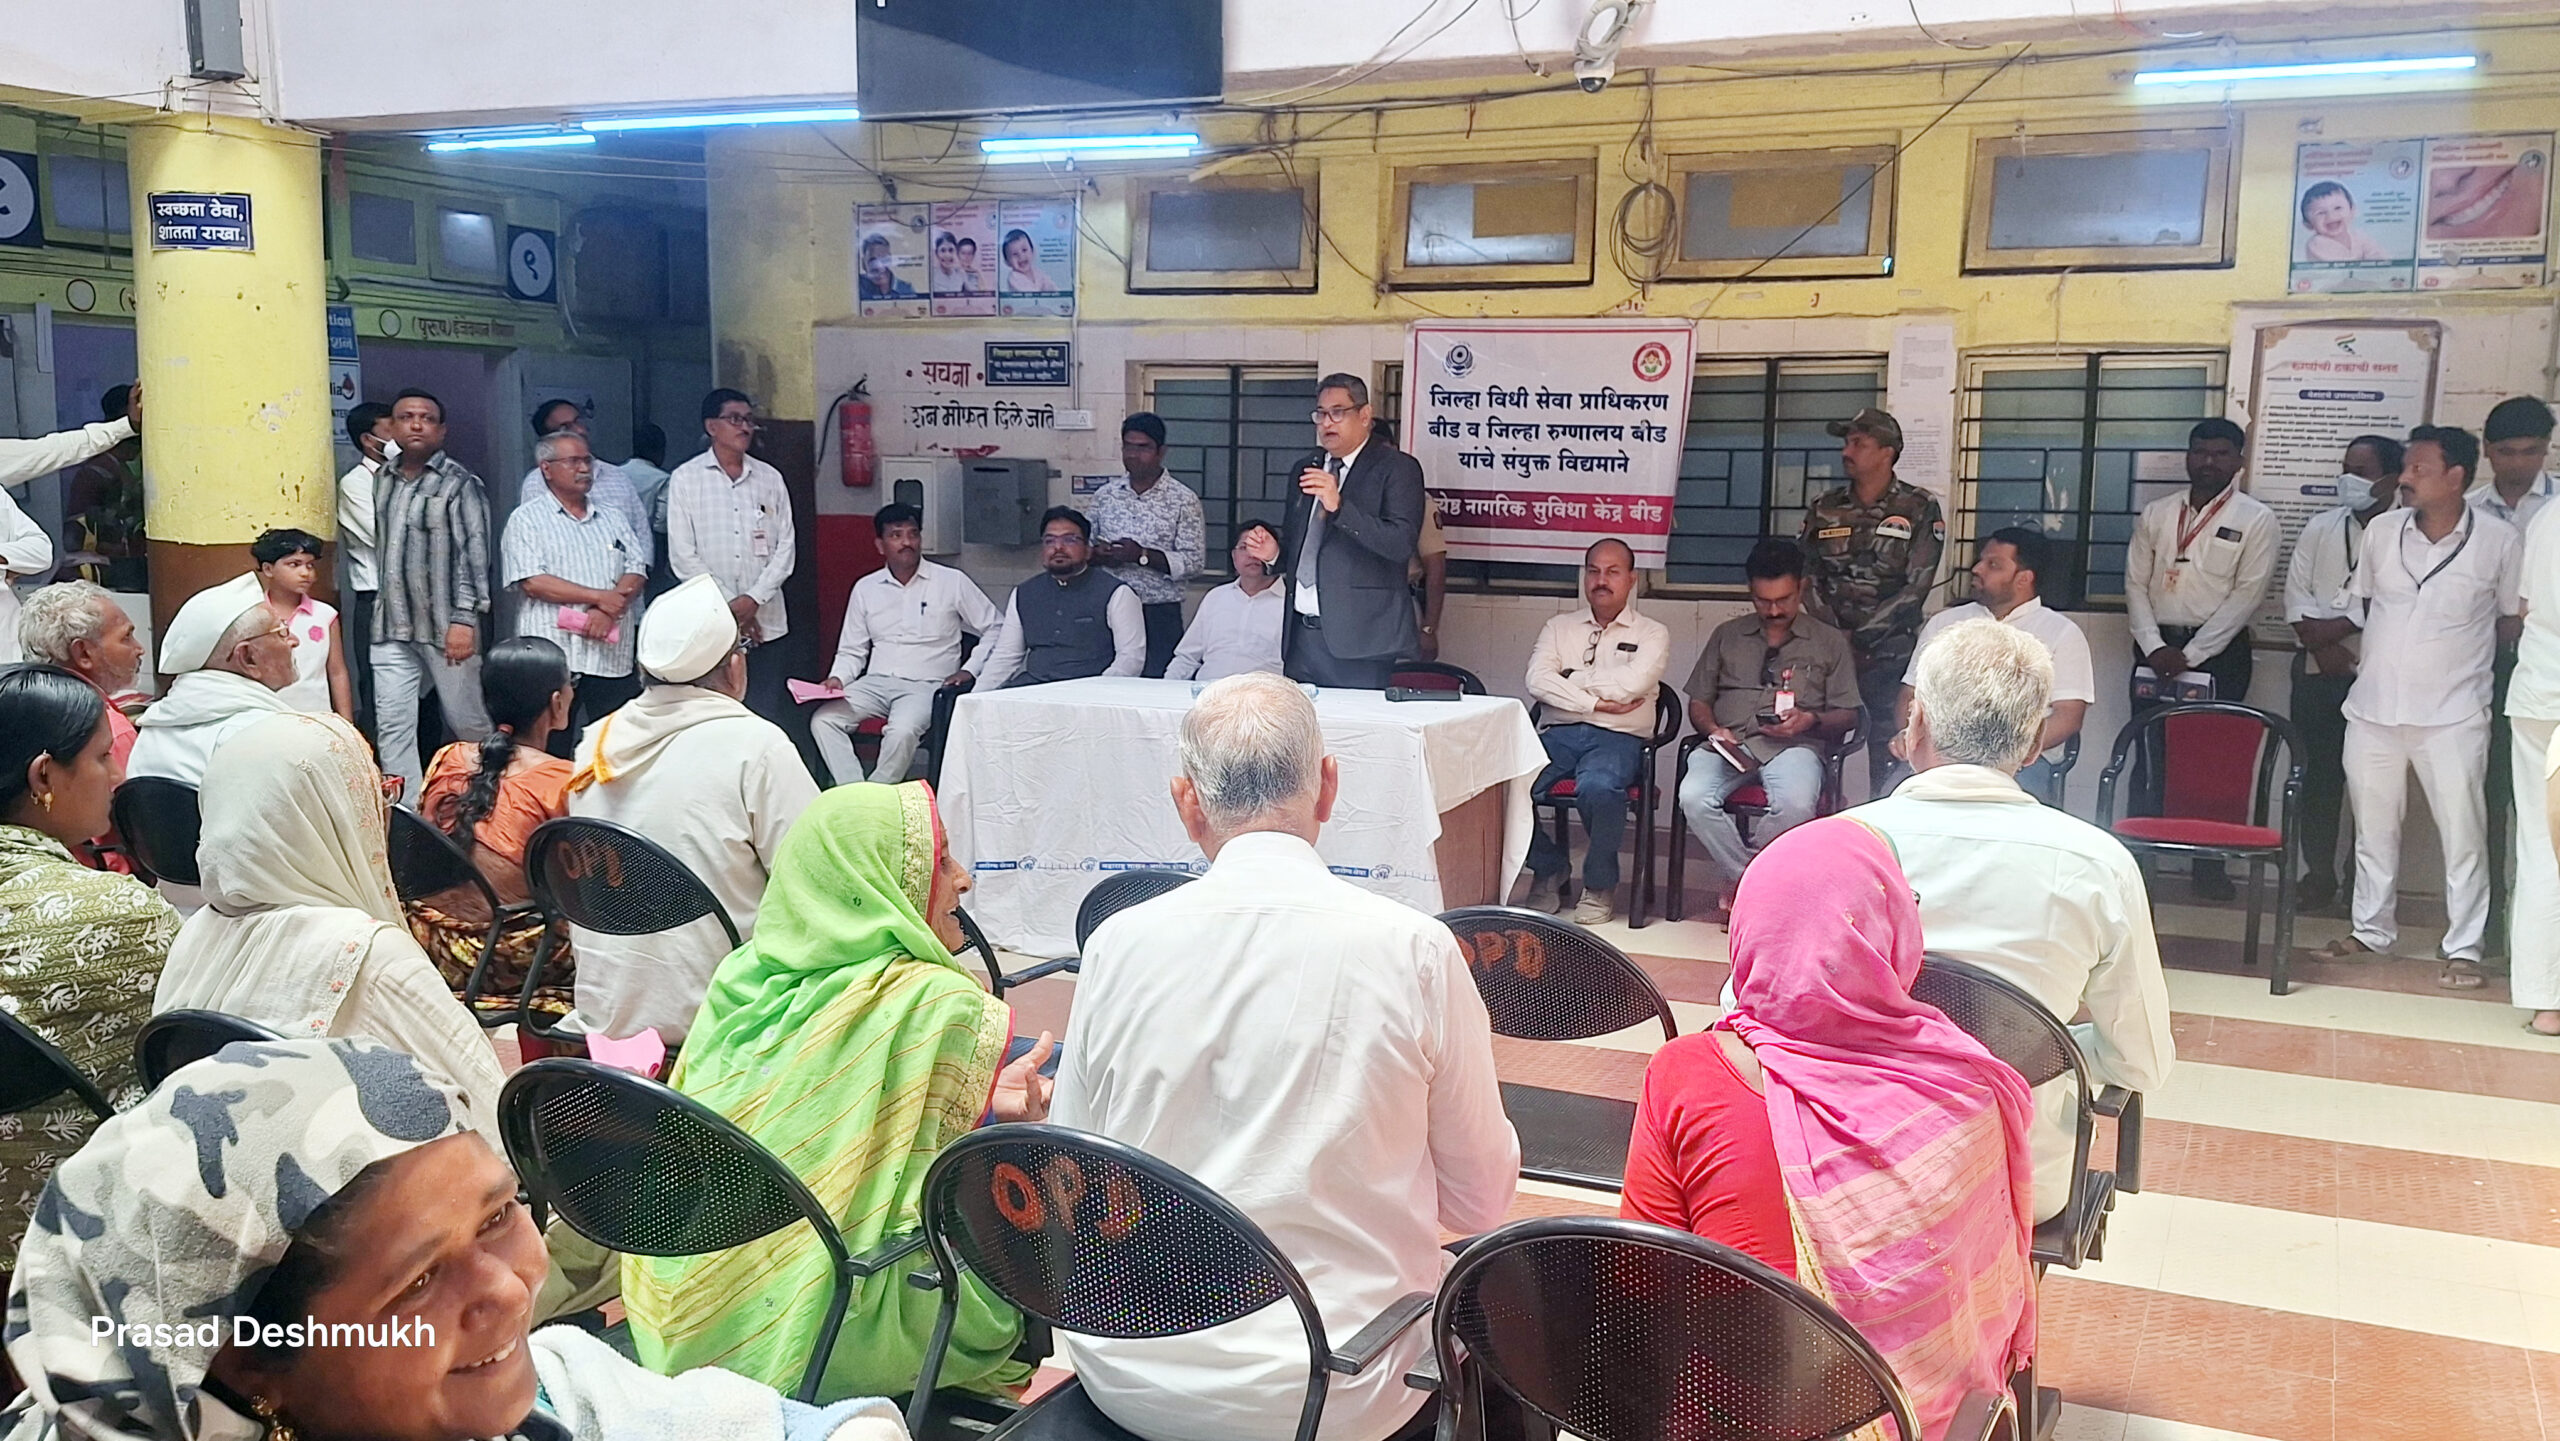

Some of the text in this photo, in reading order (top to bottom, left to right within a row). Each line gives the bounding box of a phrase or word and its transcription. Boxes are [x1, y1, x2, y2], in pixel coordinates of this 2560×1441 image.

[156, 198, 244, 221] स्वच्छता ठेवा,
[158, 220, 245, 241] शांतता राखा.
[1429, 383, 1669, 411] जिल्हा विधी सेवा प्राधिकरण
[941, 400, 989, 429] मोफत
[993, 400, 1023, 430] दिले
[1428, 415, 1667, 443] बीड व जिल्हा रुग्णालय बीड
[1458, 445, 1630, 478] यांचे संयुक्त विद्यमाने
[1464, 494, 1527, 517] नागरिक
[1532, 496, 1587, 525] सुविधा
[1593, 496, 1623, 523] केंद्र
[1629, 500, 1663, 522] बीड
